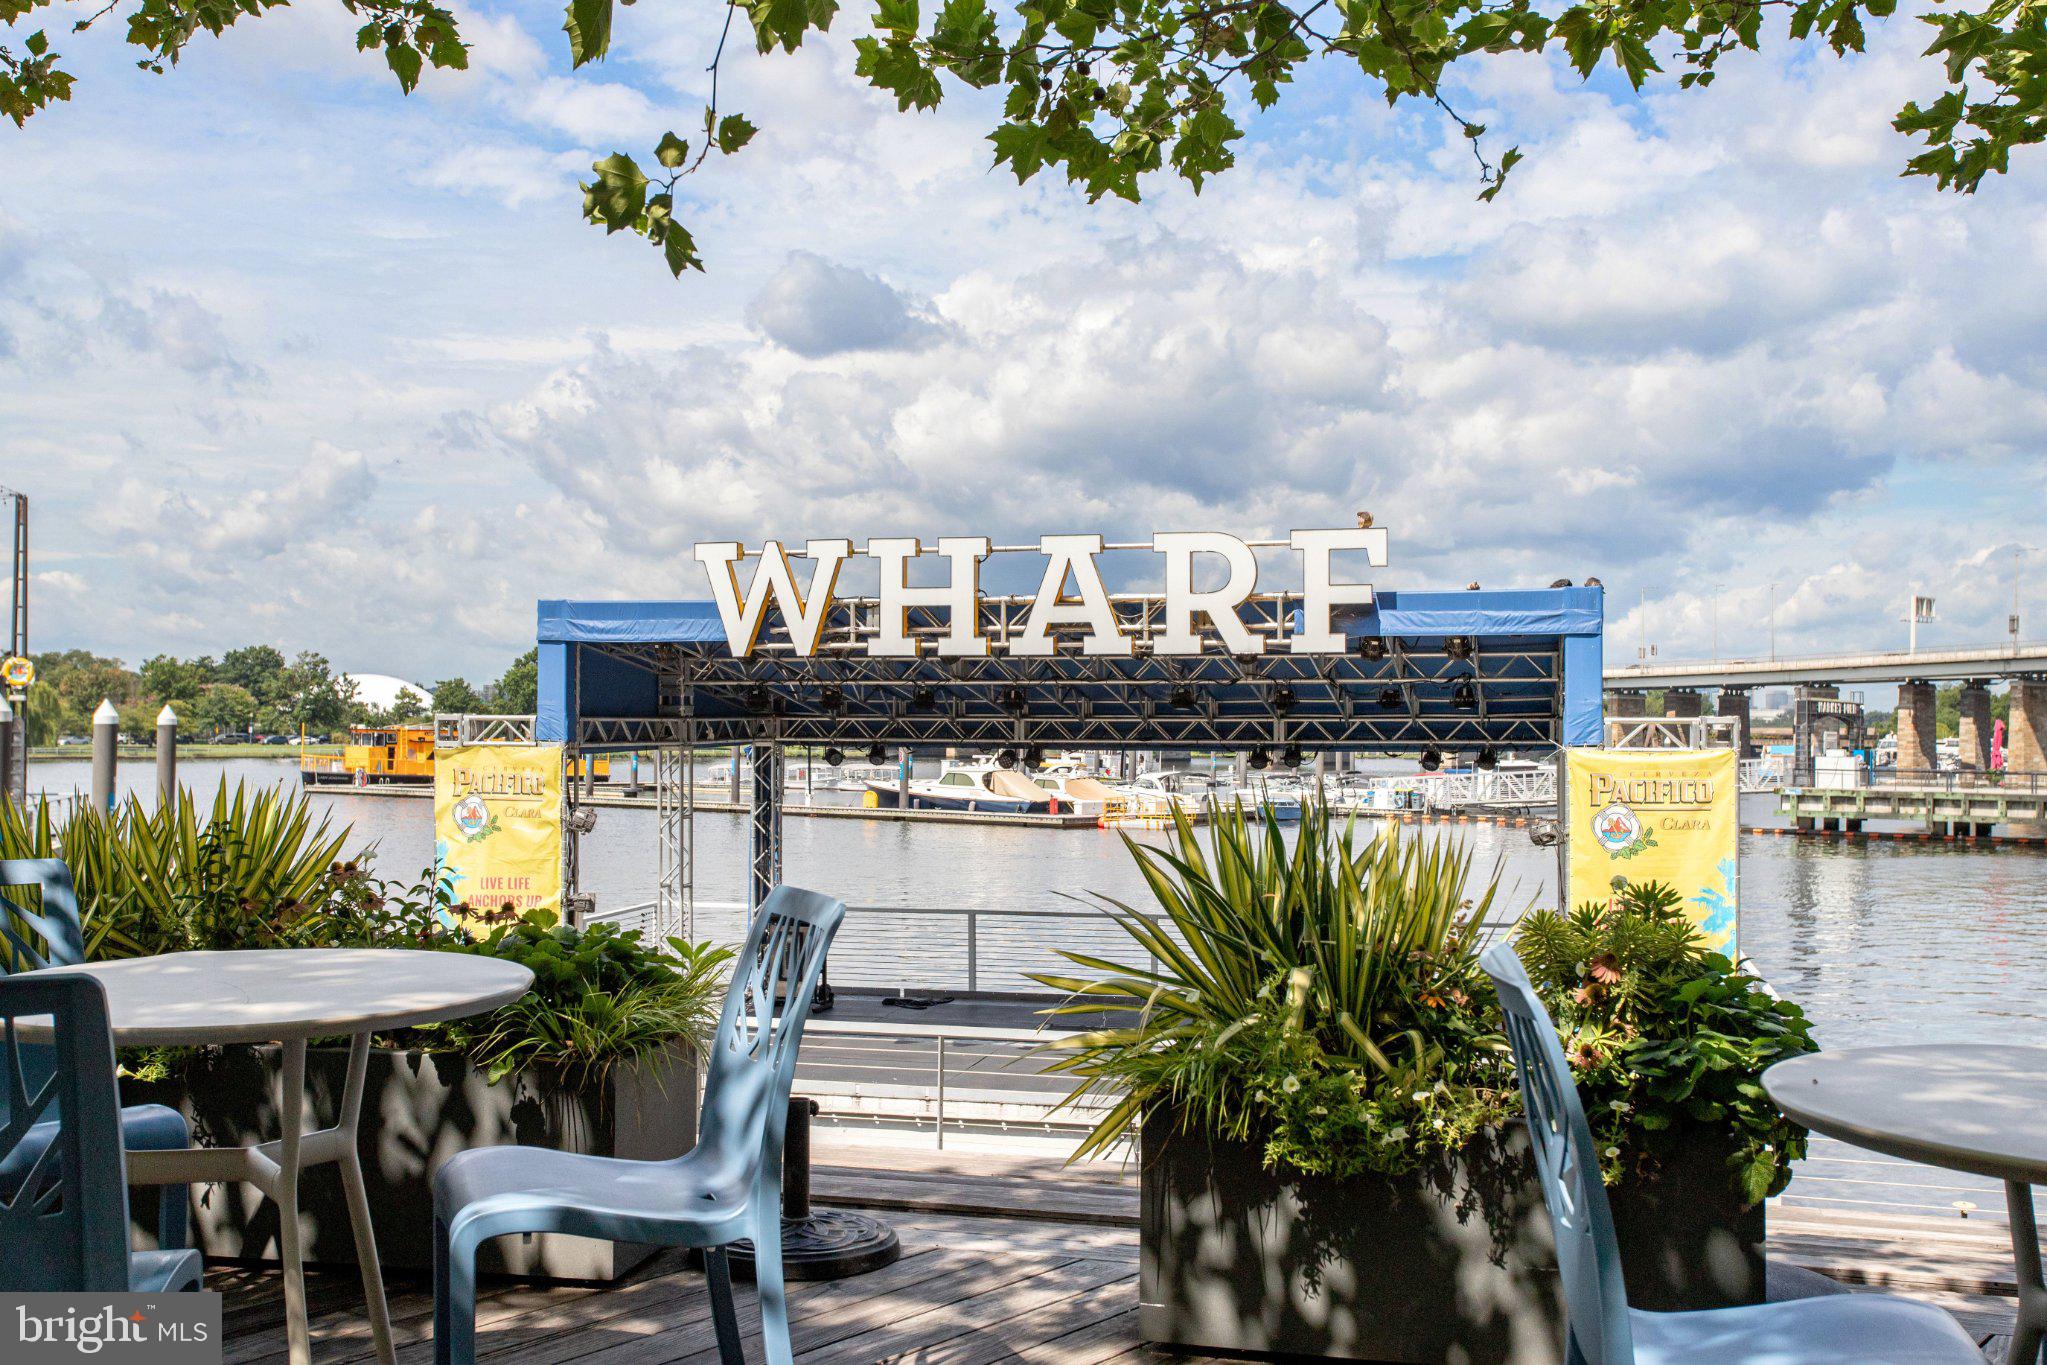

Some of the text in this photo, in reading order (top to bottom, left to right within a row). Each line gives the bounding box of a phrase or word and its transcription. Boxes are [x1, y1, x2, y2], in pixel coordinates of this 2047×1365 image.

[694, 527, 1388, 657] WHARF
[452, 767, 546, 797] PACIFICO
[1590, 773, 1714, 807] PACIFICO
[505, 806, 542, 819] CLARA
[1660, 817, 1712, 831] CLARA
[480, 877, 531, 890] LIVE LIFE
[468, 894, 543, 908] ANCHORS UP
